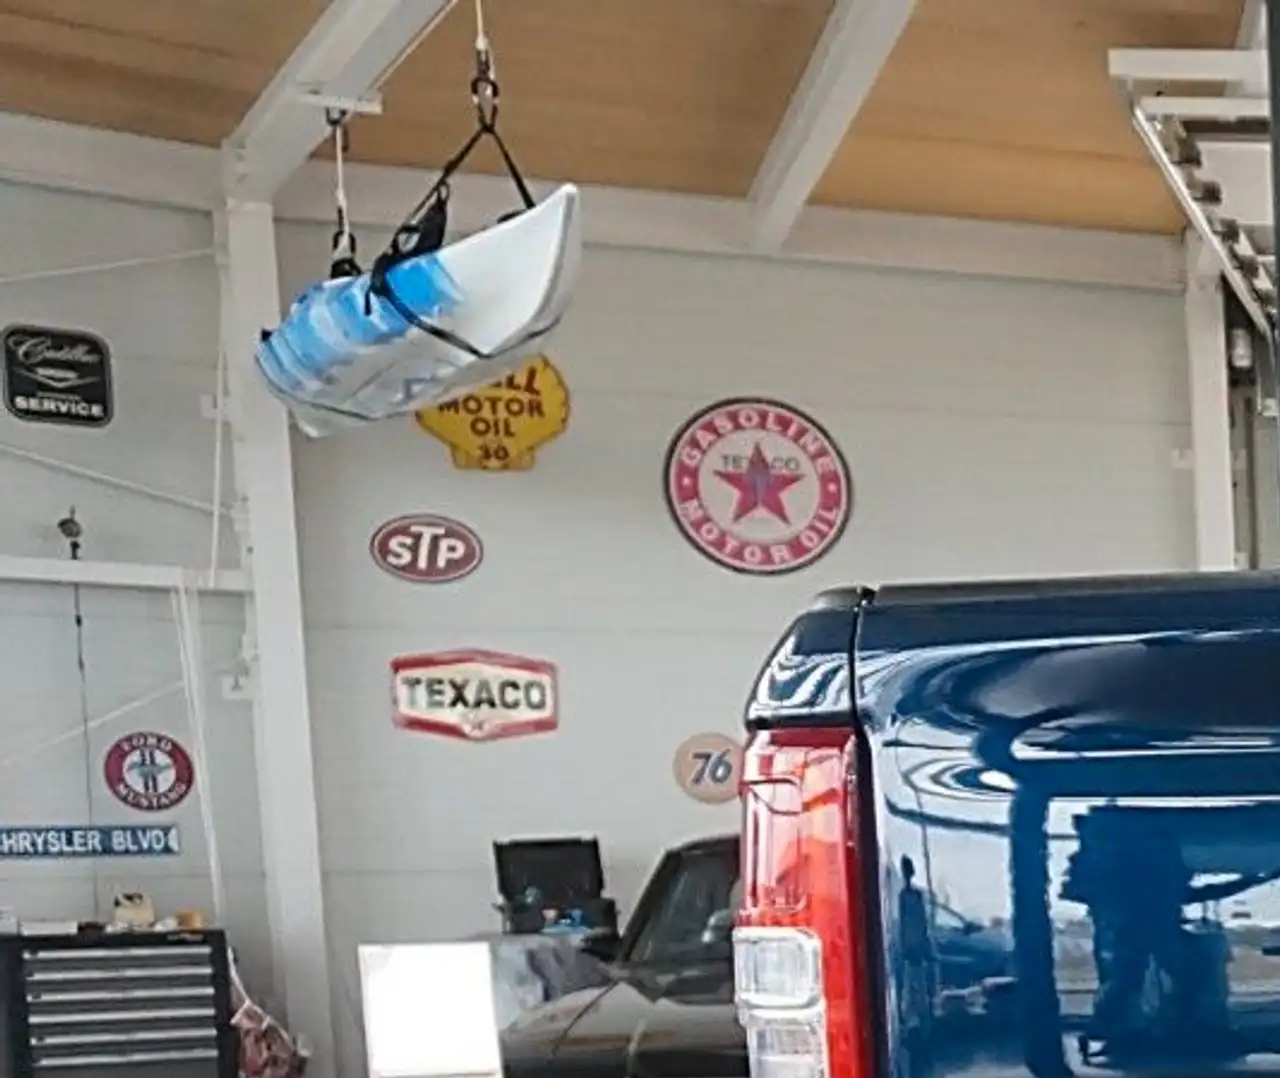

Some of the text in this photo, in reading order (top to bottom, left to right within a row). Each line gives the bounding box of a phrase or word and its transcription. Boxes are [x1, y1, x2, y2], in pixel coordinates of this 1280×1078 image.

[14, 395, 105, 418] SERVICE
[438, 394, 545, 418] MOTOR
[470, 417, 516, 437] OIL
[681, 408, 836, 474] GASOLINE
[386, 524, 467, 570] STP
[680, 499, 837, 564] MOTOR OIL
[401, 676, 547, 711] TEXACO
[691, 748, 733, 784] 76
[0, 828, 164, 853] HRYSLER BLVD
